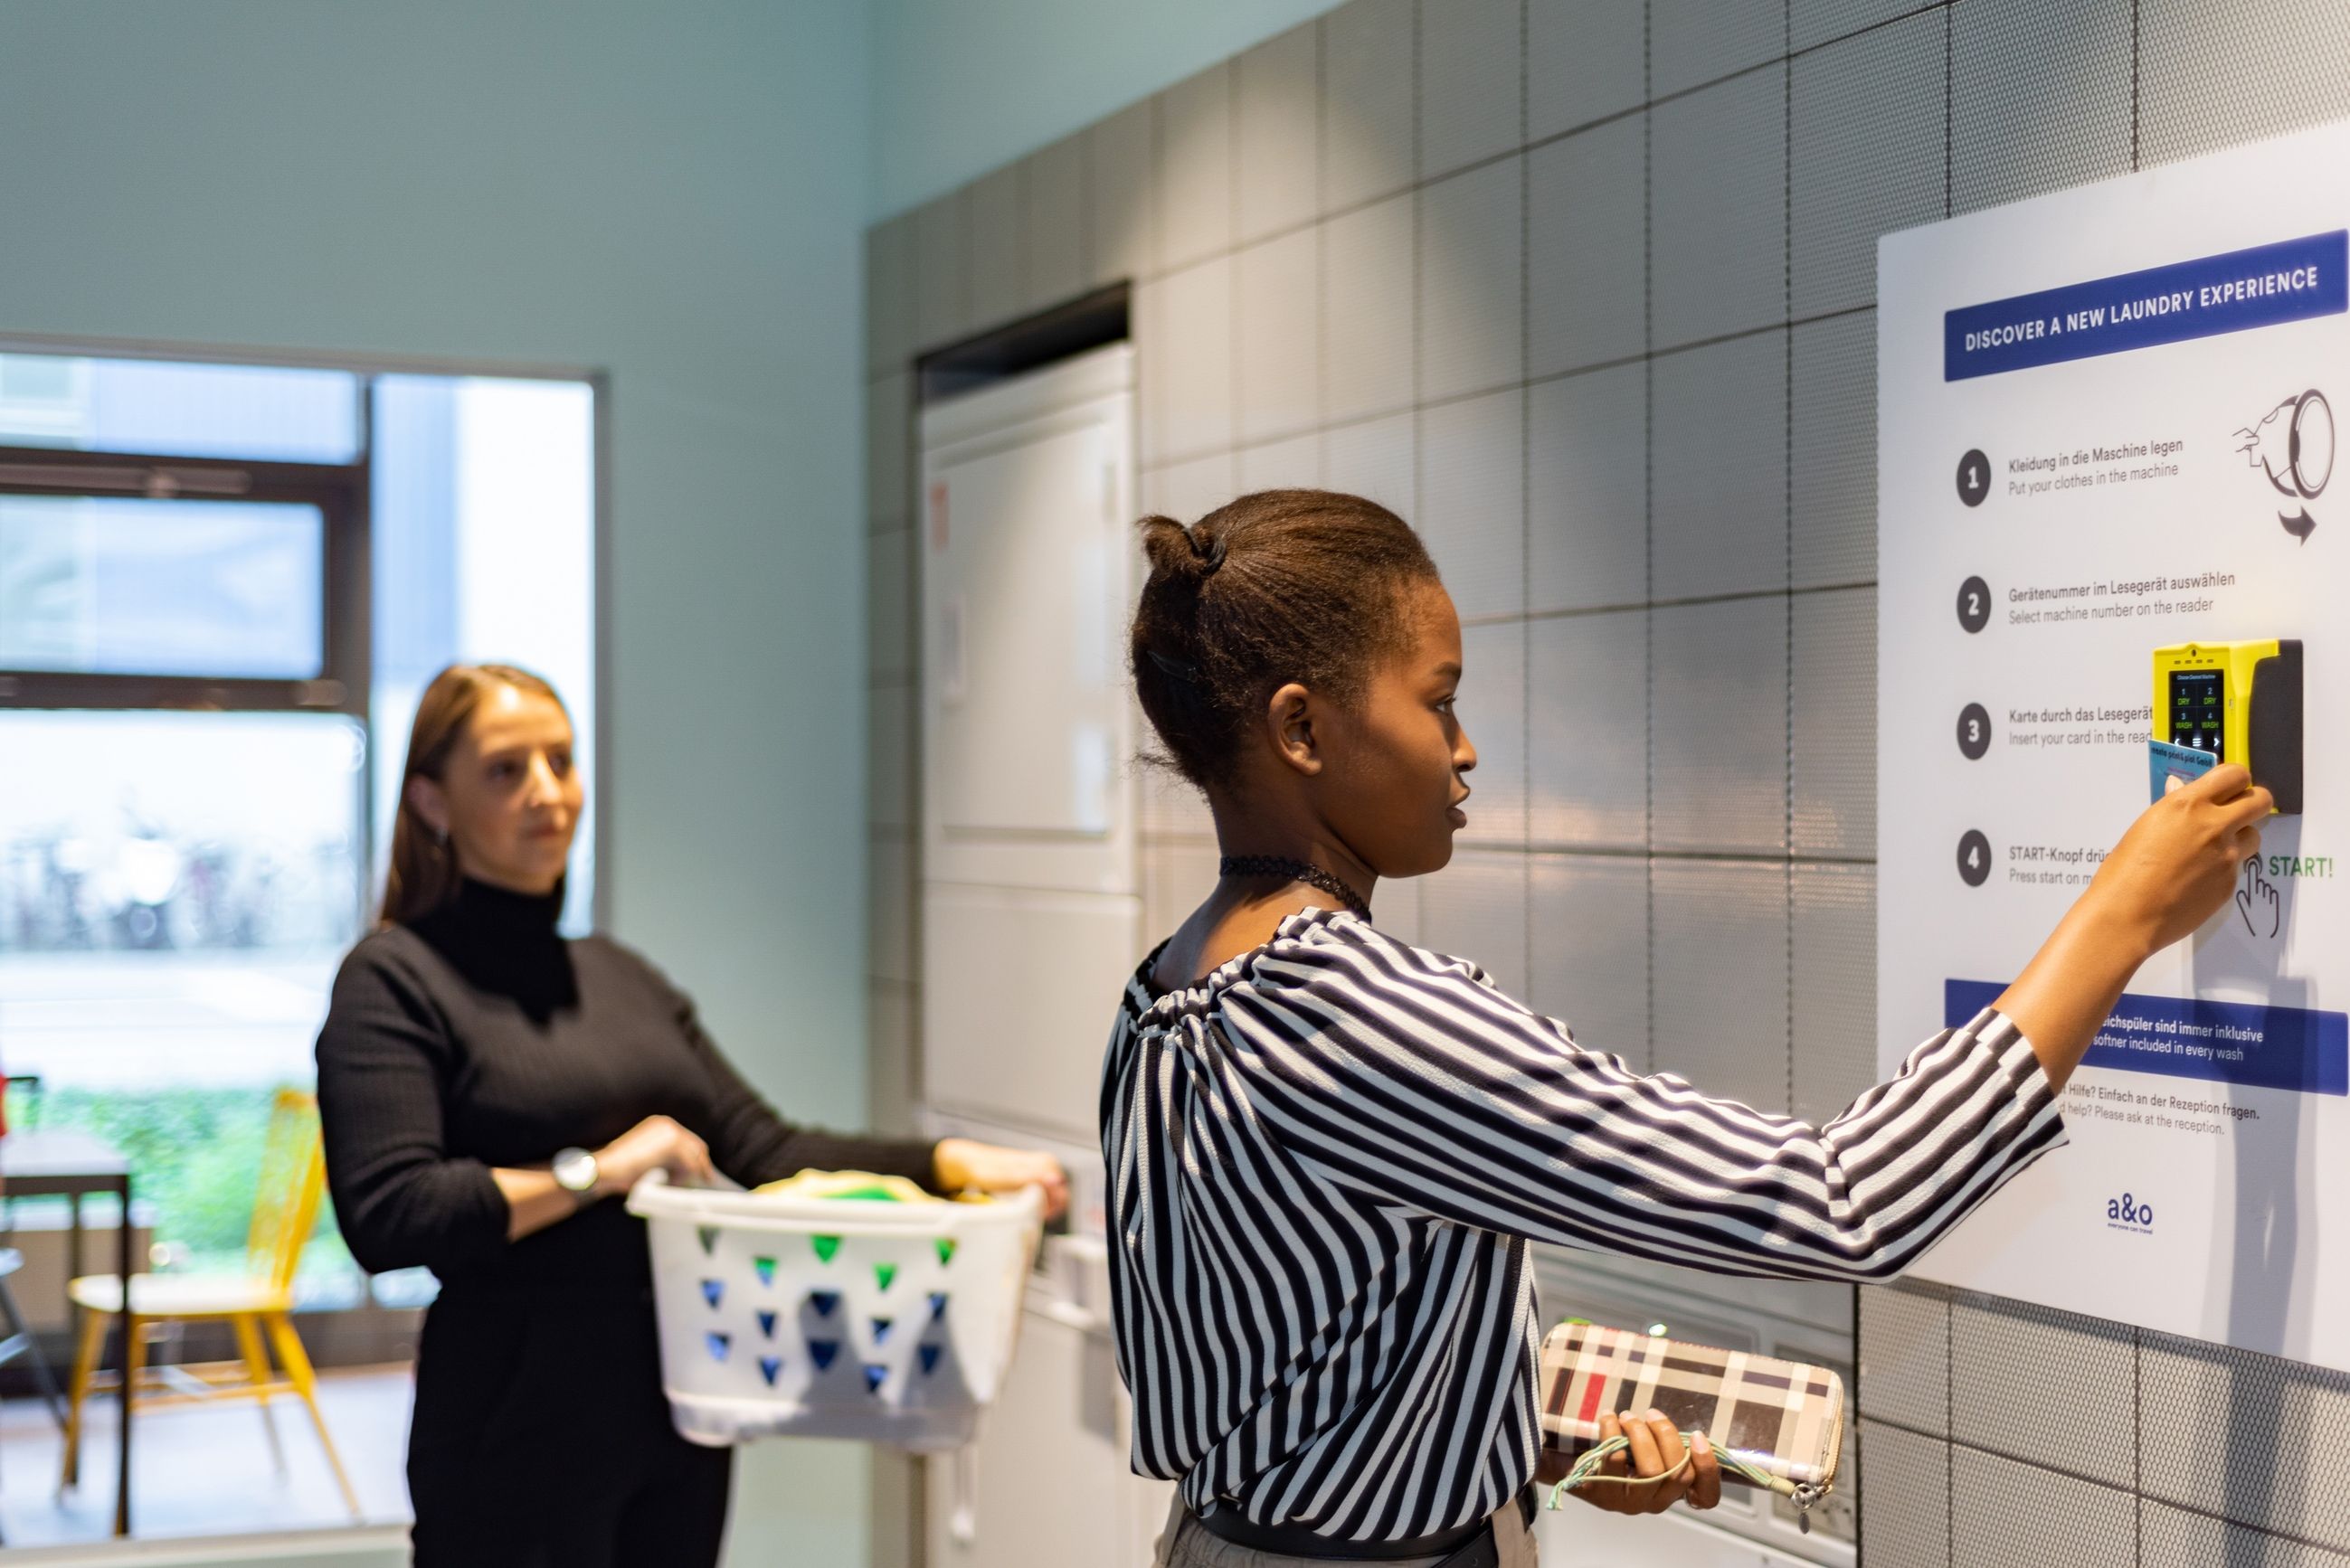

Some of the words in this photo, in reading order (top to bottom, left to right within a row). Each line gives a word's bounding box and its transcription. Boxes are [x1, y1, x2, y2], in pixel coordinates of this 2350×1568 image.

[1966, 320, 2044, 352] DISCOVER
[2050, 316, 2061, 335] A
[2067, 307, 2106, 332] NEW
[2110, 290, 2194, 324] LAUNDRY
[2200, 267, 2318, 307] EXPERIENCE
[2009, 457, 2056, 474] Kleidung
[2059, 453, 2069, 467] in
[2072, 449, 2089, 465] die
[2092, 443, 2147, 462] Maschine
[2151, 440, 2183, 457] legen
[1968, 466, 1979, 489] 1
[2009, 481, 2026, 496] Put
[2028, 481, 2052, 496] your
[2054, 474, 2093, 490] clothes
[2096, 470, 2106, 485] in
[2109, 468, 2127, 484] the
[2130, 462, 2178, 481] machine
[2009, 586, 2090, 602] Gerätenummer
[2093, 581, 2108, 596] im
[2110, 577, 2167, 596] Lesegerät
[2170, 571, 2235, 590] auswählen
[1968, 592, 1979, 616] 2
[2009, 609, 2041, 625] Select
[2043, 605, 2089, 622] machine
[2091, 602, 2134, 619] number
[2137, 604, 2151, 616] on
[2154, 600, 2173, 614] the
[2175, 597, 2214, 613] reader
[2177, 697, 2190, 705] DRY
[2203, 696, 2216, 705] DRY
[2181, 687, 2186, 695] 1
[2207, 686, 2213, 695] 2
[2009, 709, 2038, 723] Karte
[2041, 708, 2072, 723] durch
[2075, 707, 2095, 722] das
[2098, 705, 2152, 724] Lesegerät
[2201, 721, 2219, 729] WASH
[1968, 720, 1979, 742] 3
[2009, 731, 2038, 746] Insert
[2041, 732, 2064, 748] your
[2067, 730, 2090, 744] card
[2094, 729, 2104, 743] in
[2107, 729, 2125, 743] the
[2127, 728, 2152, 743] read
[1967, 845, 1980, 869] 4
[2009, 845, 2083, 865] START-Knopf
[2269, 855, 2333, 878] START!
[2009, 868, 2037, 883] Press
[2039, 871, 2063, 884] start
[2065, 874, 2080, 885] on
[2155, 1018, 2176, 1034] sind
[2179, 1021, 2213, 1037] immer
[2215, 1025, 2264, 1043] inklusive
[2093, 1033, 2127, 1049] softner
[2129, 1035, 2171, 1053] included
[2174, 1041, 2184, 1054] in
[2185, 1046, 2214, 1062] every
[2216, 1047, 2244, 1062] wash
[2069, 1084, 2097, 1099] Hilfe?
[2099, 1087, 2134, 1103] Einfach
[2136, 1094, 2148, 1105] an
[2150, 1093, 2167, 1108] der
[2170, 1096, 2220, 1115] Rezeption
[2222, 1102, 2260, 1121] fragen.
[2068, 1102, 2093, 1118] help?
[2095, 1105, 2125, 1122] Please
[2126, 1110, 2143, 1124] ask
[2145, 1113, 2155, 1127] at
[2156, 1115, 2173, 1129] the
[2175, 1119, 2225, 1136] reception.
[2108, 1192, 2153, 1225] a&o
